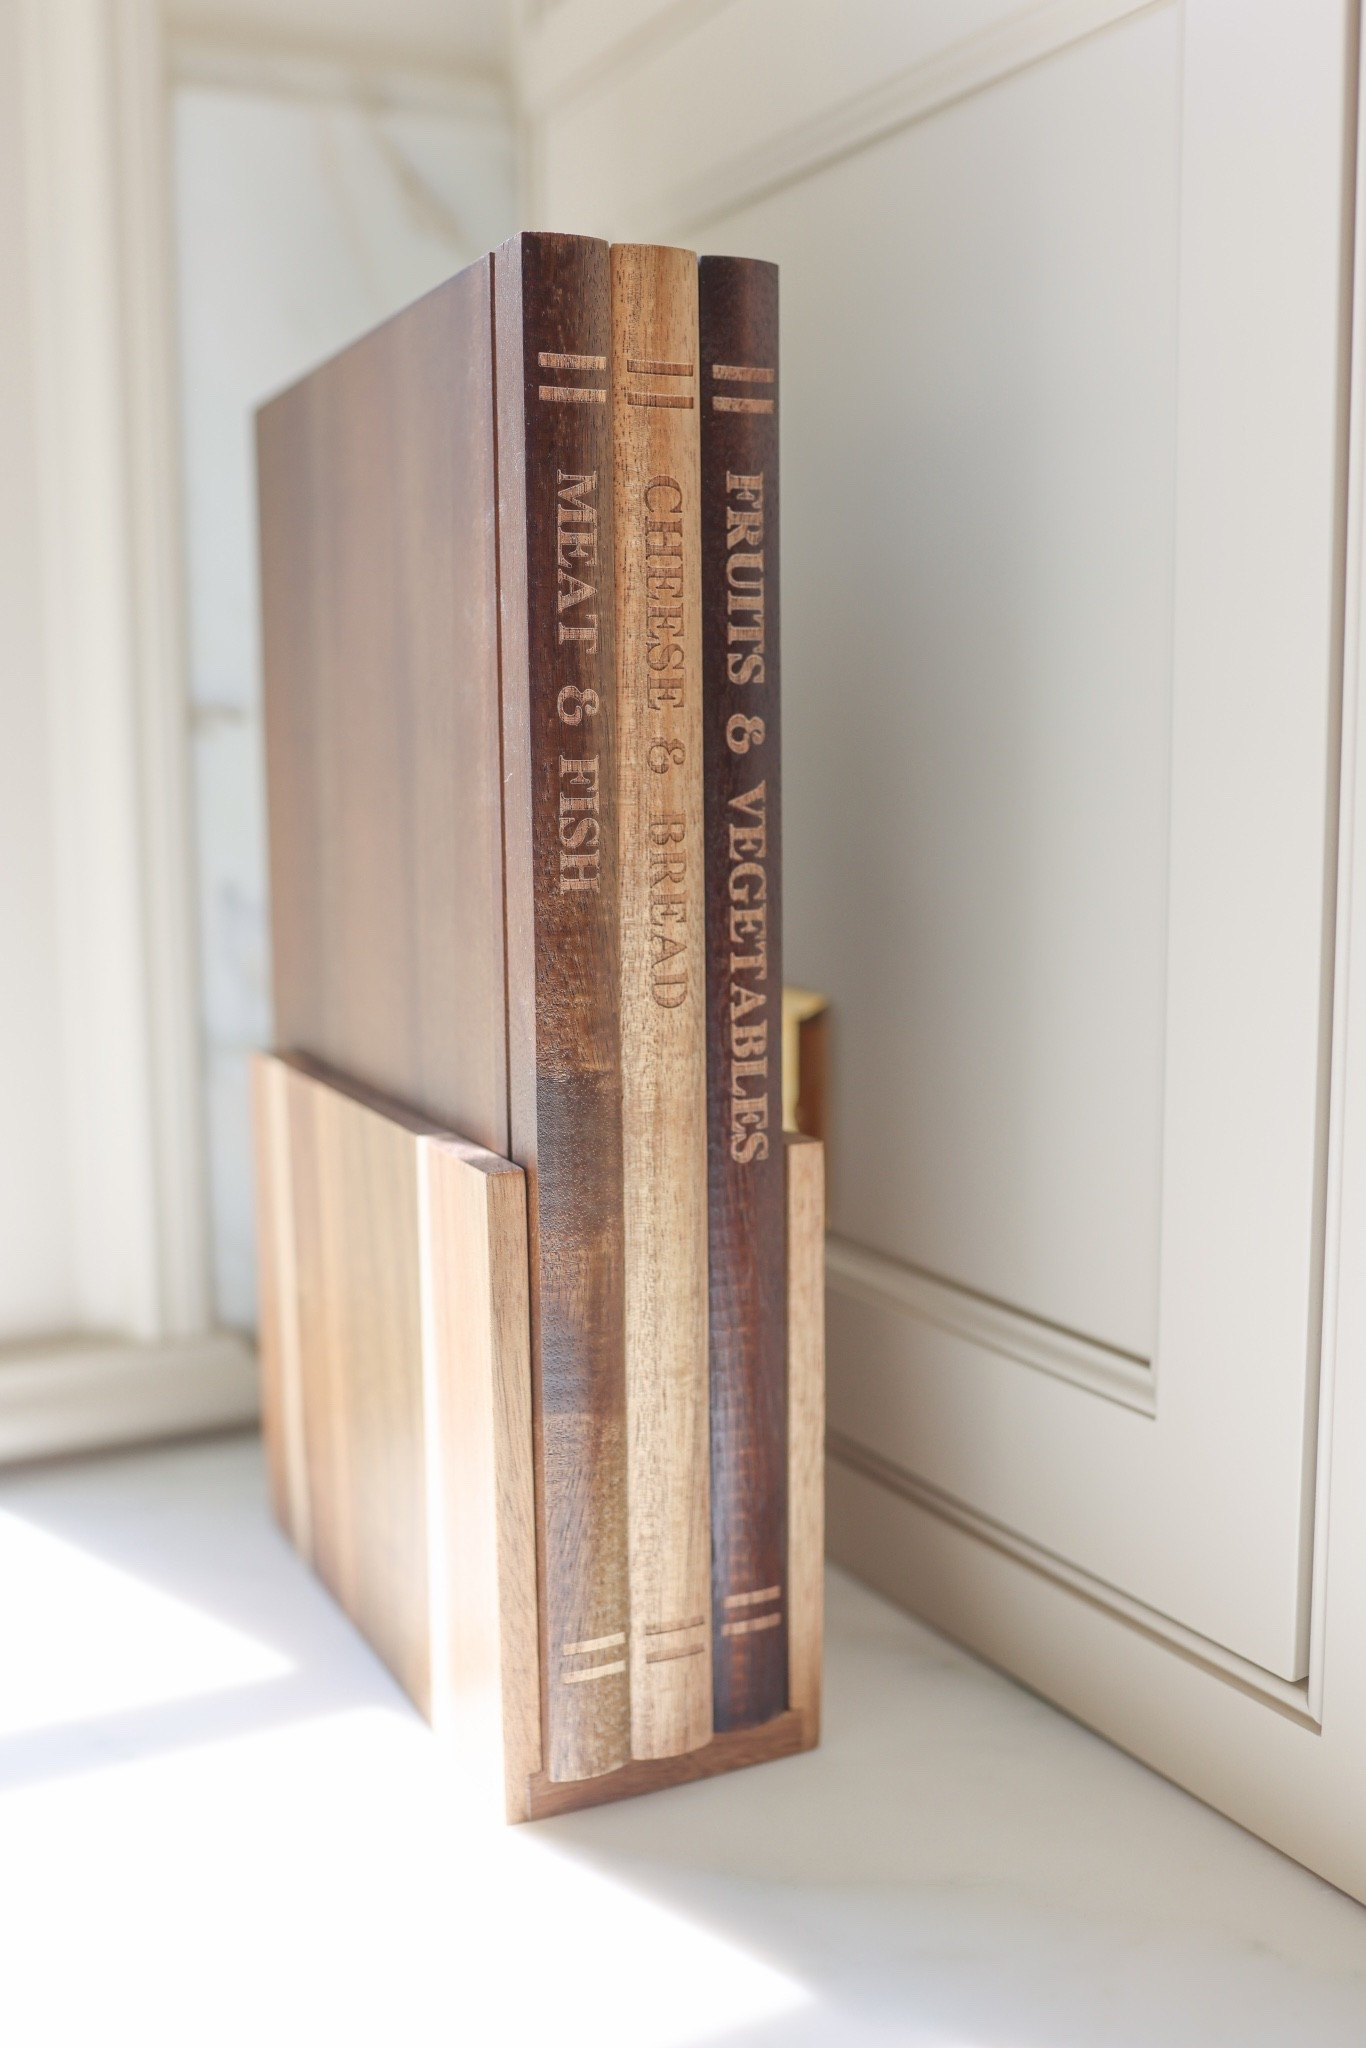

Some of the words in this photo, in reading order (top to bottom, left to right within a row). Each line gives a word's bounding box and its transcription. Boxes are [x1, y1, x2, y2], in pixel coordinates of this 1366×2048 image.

[557, 469, 598, 654] MEAT
[644, 475, 685, 710] CHEESE
[726, 470, 765, 685] FRUITS
[557, 685, 600, 726] &
[645, 736, 686, 774] &
[726, 713, 766, 754] &
[559, 754, 600, 895] FISH
[649, 809, 689, 1009] BREAD
[727, 780, 769, 1164] VEGETABLES
